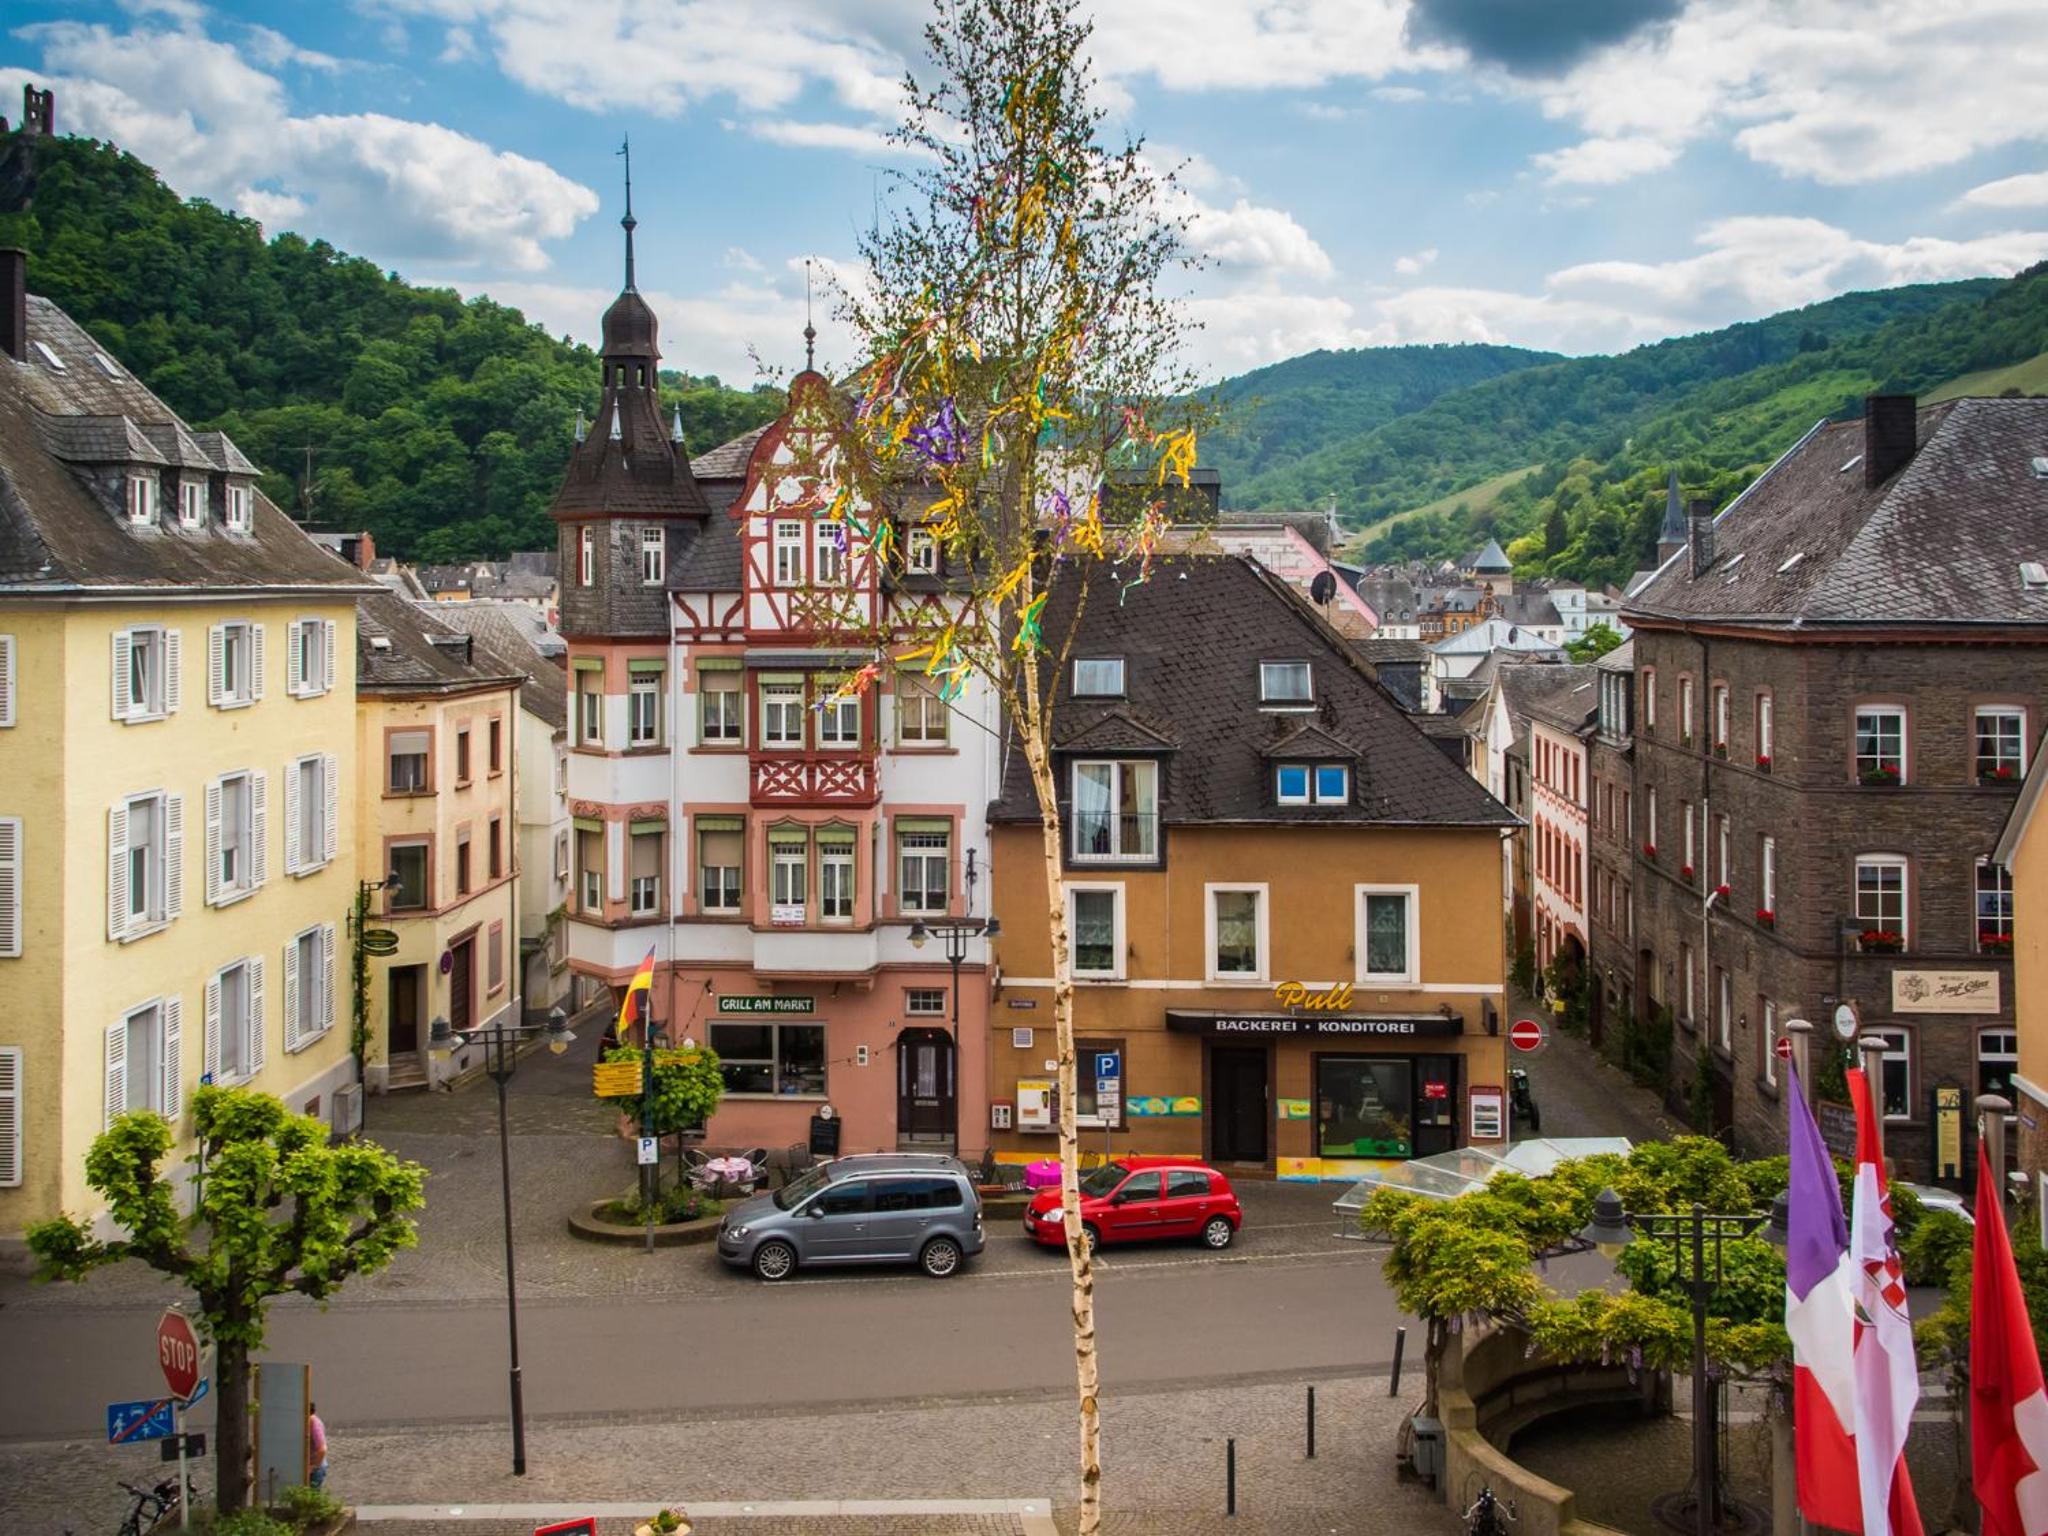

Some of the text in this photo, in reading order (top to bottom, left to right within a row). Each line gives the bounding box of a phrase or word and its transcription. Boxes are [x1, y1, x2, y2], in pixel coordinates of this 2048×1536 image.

[722, 999, 811, 1010] GRILL AM MARKT
[1318, 1022, 1415, 1033] KONDITOREI
[1101, 1058, 1114, 1075] P
[642, 1139, 652, 1151] P
[160, 1335, 195, 1374] STOP
